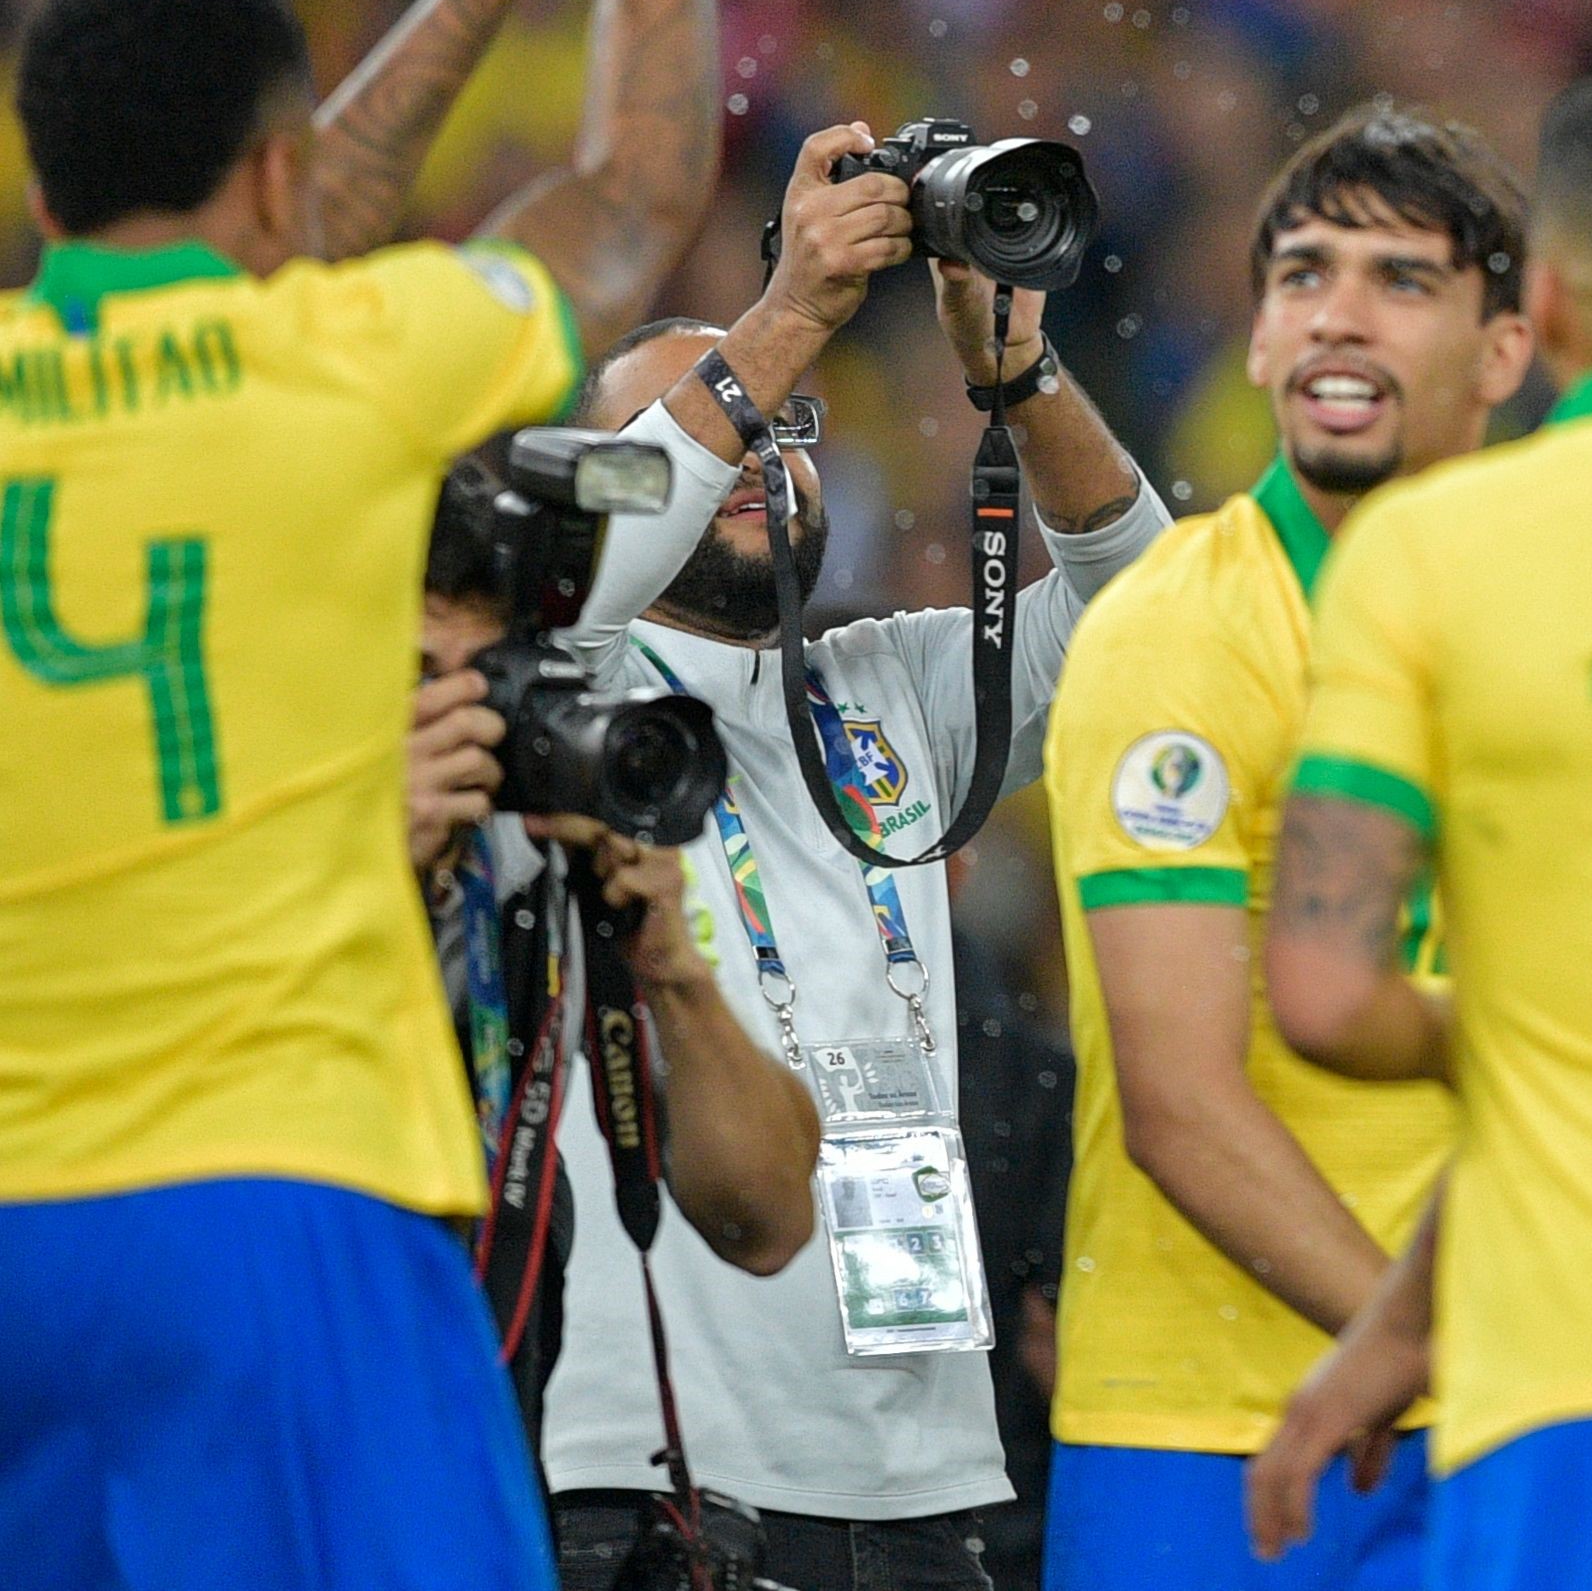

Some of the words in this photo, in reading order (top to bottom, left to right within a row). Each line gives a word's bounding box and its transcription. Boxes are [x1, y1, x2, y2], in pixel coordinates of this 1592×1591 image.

[932, 133, 969, 143] SONY
[715, 376, 743, 403] 21
[984, 530, 1007, 650] SONY
[0, 477, 223, 824] 4
[857, 752, 874, 770] BF
[877, 800, 931, 839] BRASIL
[826, 1052, 846, 1066] 26
[601, 1009, 641, 1149] Canon
